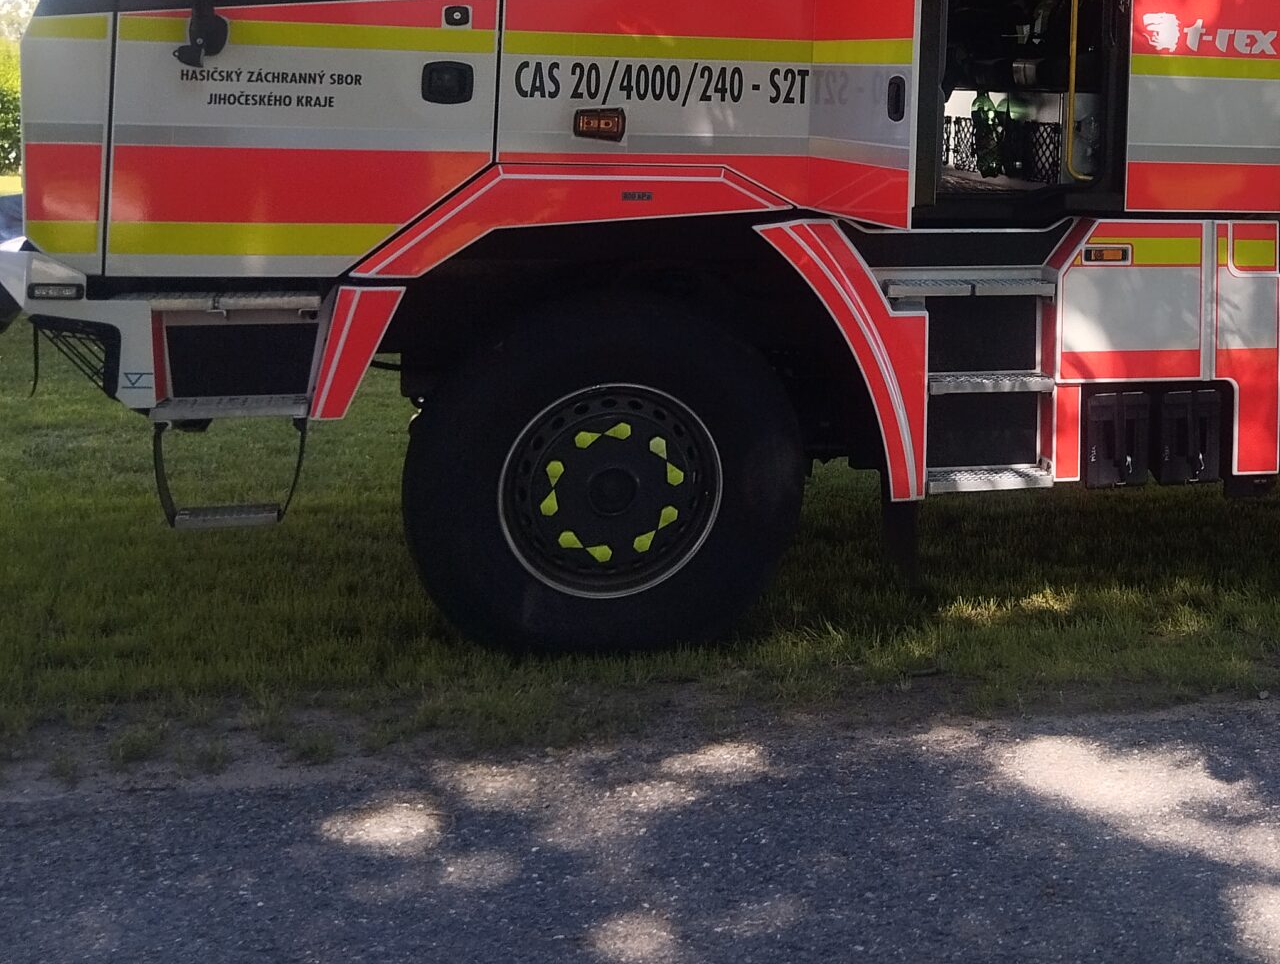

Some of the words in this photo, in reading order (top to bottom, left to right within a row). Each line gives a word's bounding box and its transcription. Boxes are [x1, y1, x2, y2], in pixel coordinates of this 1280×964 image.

[180, 67, 243, 83] HASIČSKÝ
[247, 68, 326, 85] ZÁCHRANNÝ
[329, 73, 362, 86] SBOR
[514, 61, 560, 99] CAS
[570, 60, 743, 107] 20/4000/240
[769, 67, 809, 104] S2T
[207, 91, 292, 107] JIHOČESKÉHO
[296, 95, 335, 108] KRAJE
